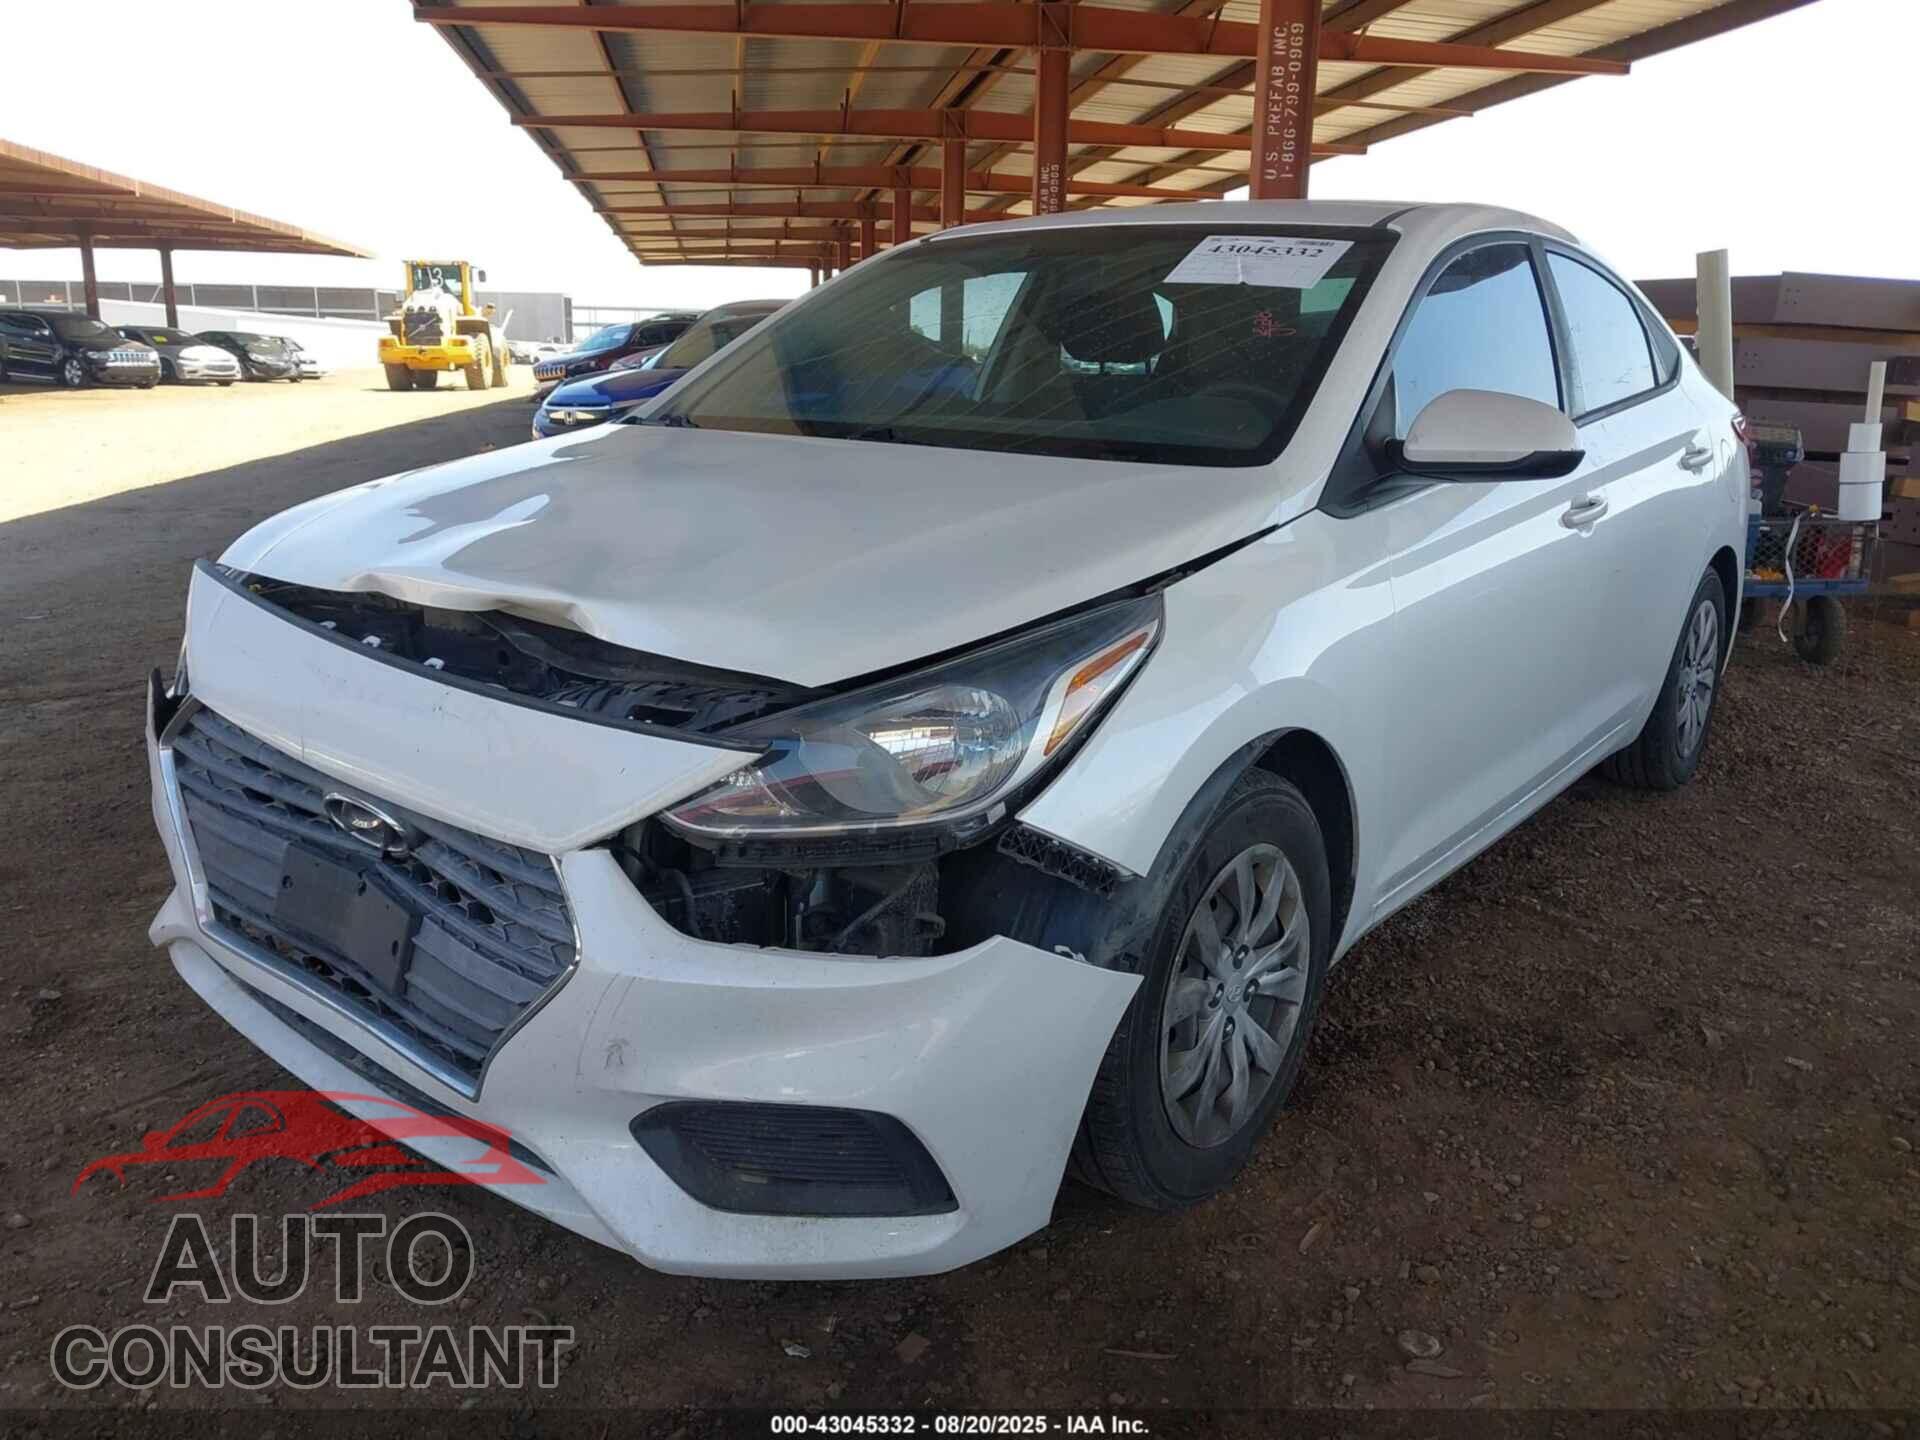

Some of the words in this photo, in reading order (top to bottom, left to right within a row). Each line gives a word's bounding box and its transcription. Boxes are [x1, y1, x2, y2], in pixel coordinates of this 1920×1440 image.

[1273, 22, 1288, 55] INC.
[1267, 66, 1285, 136] PREFAB
[1264, 147, 1279, 180] U.S.
[1208, 244, 1324, 258] 43045332
